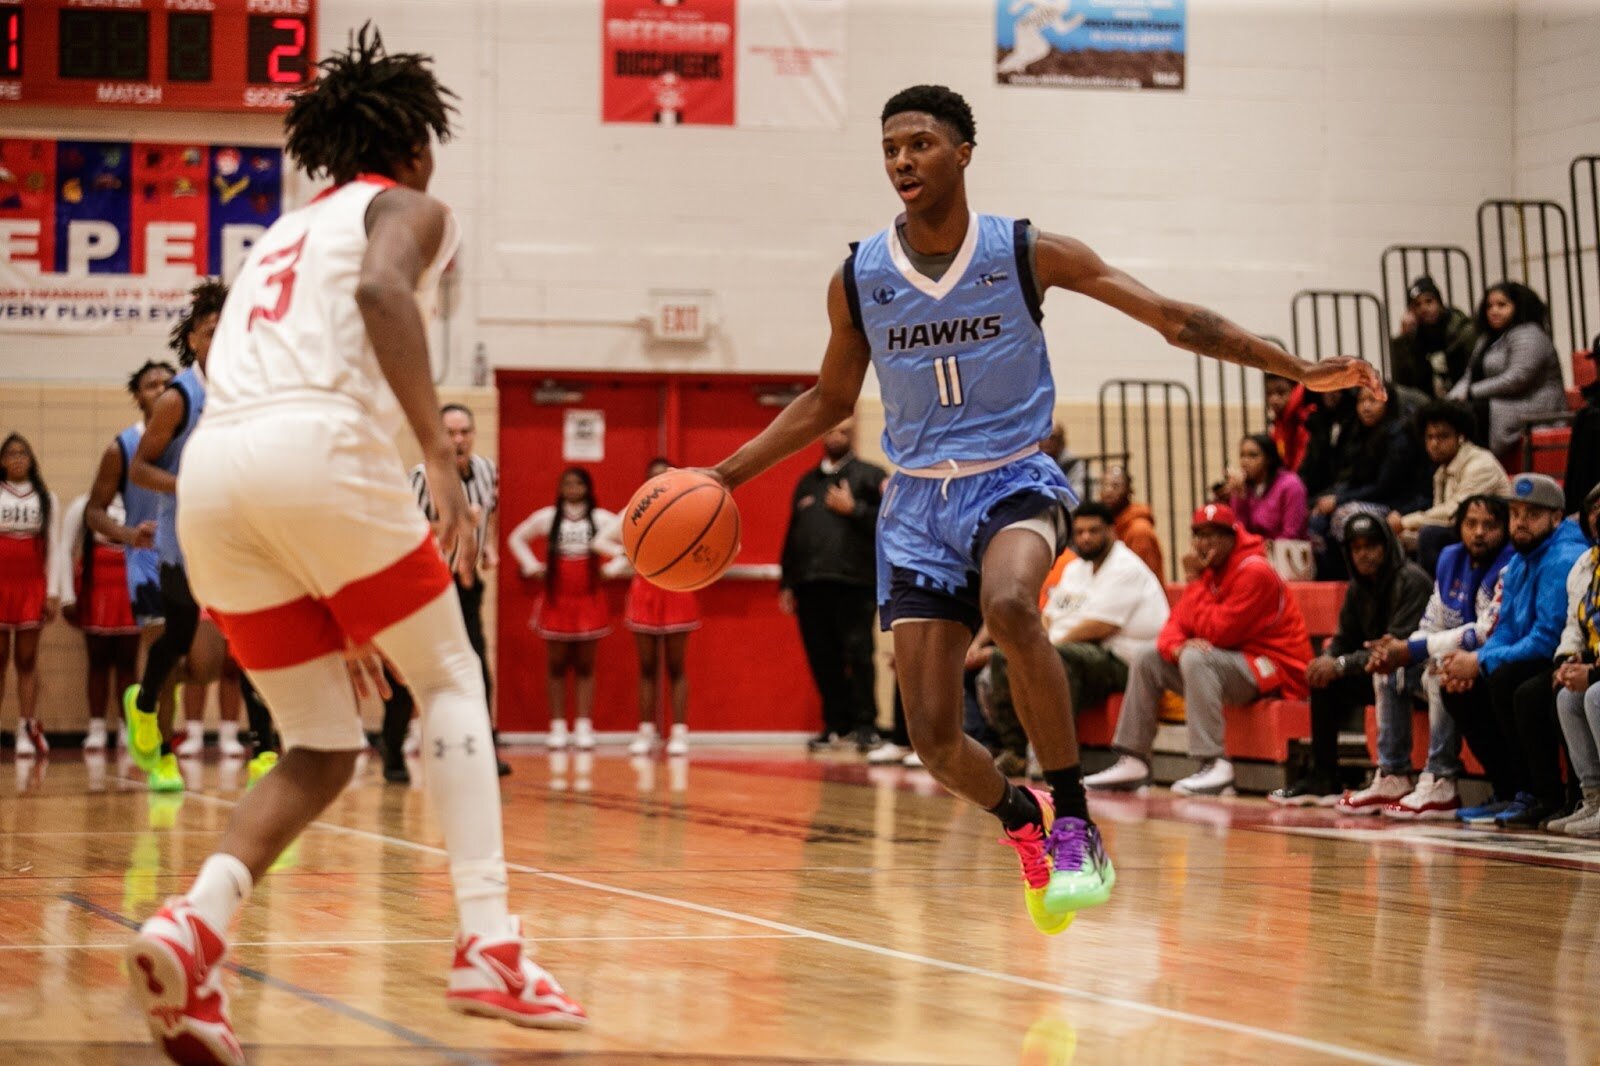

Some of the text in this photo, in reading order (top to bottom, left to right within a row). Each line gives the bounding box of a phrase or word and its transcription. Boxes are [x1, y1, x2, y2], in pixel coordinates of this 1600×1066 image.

[267, 18, 305, 83] 2
[96, 84, 162, 104] MATCH
[246, 228, 309, 333] 3
[57, 304, 140, 320] PLAYER
[663, 305, 699, 332] EXIT
[888, 313, 1003, 351] HAWKS
[933, 355, 964, 408] 11
